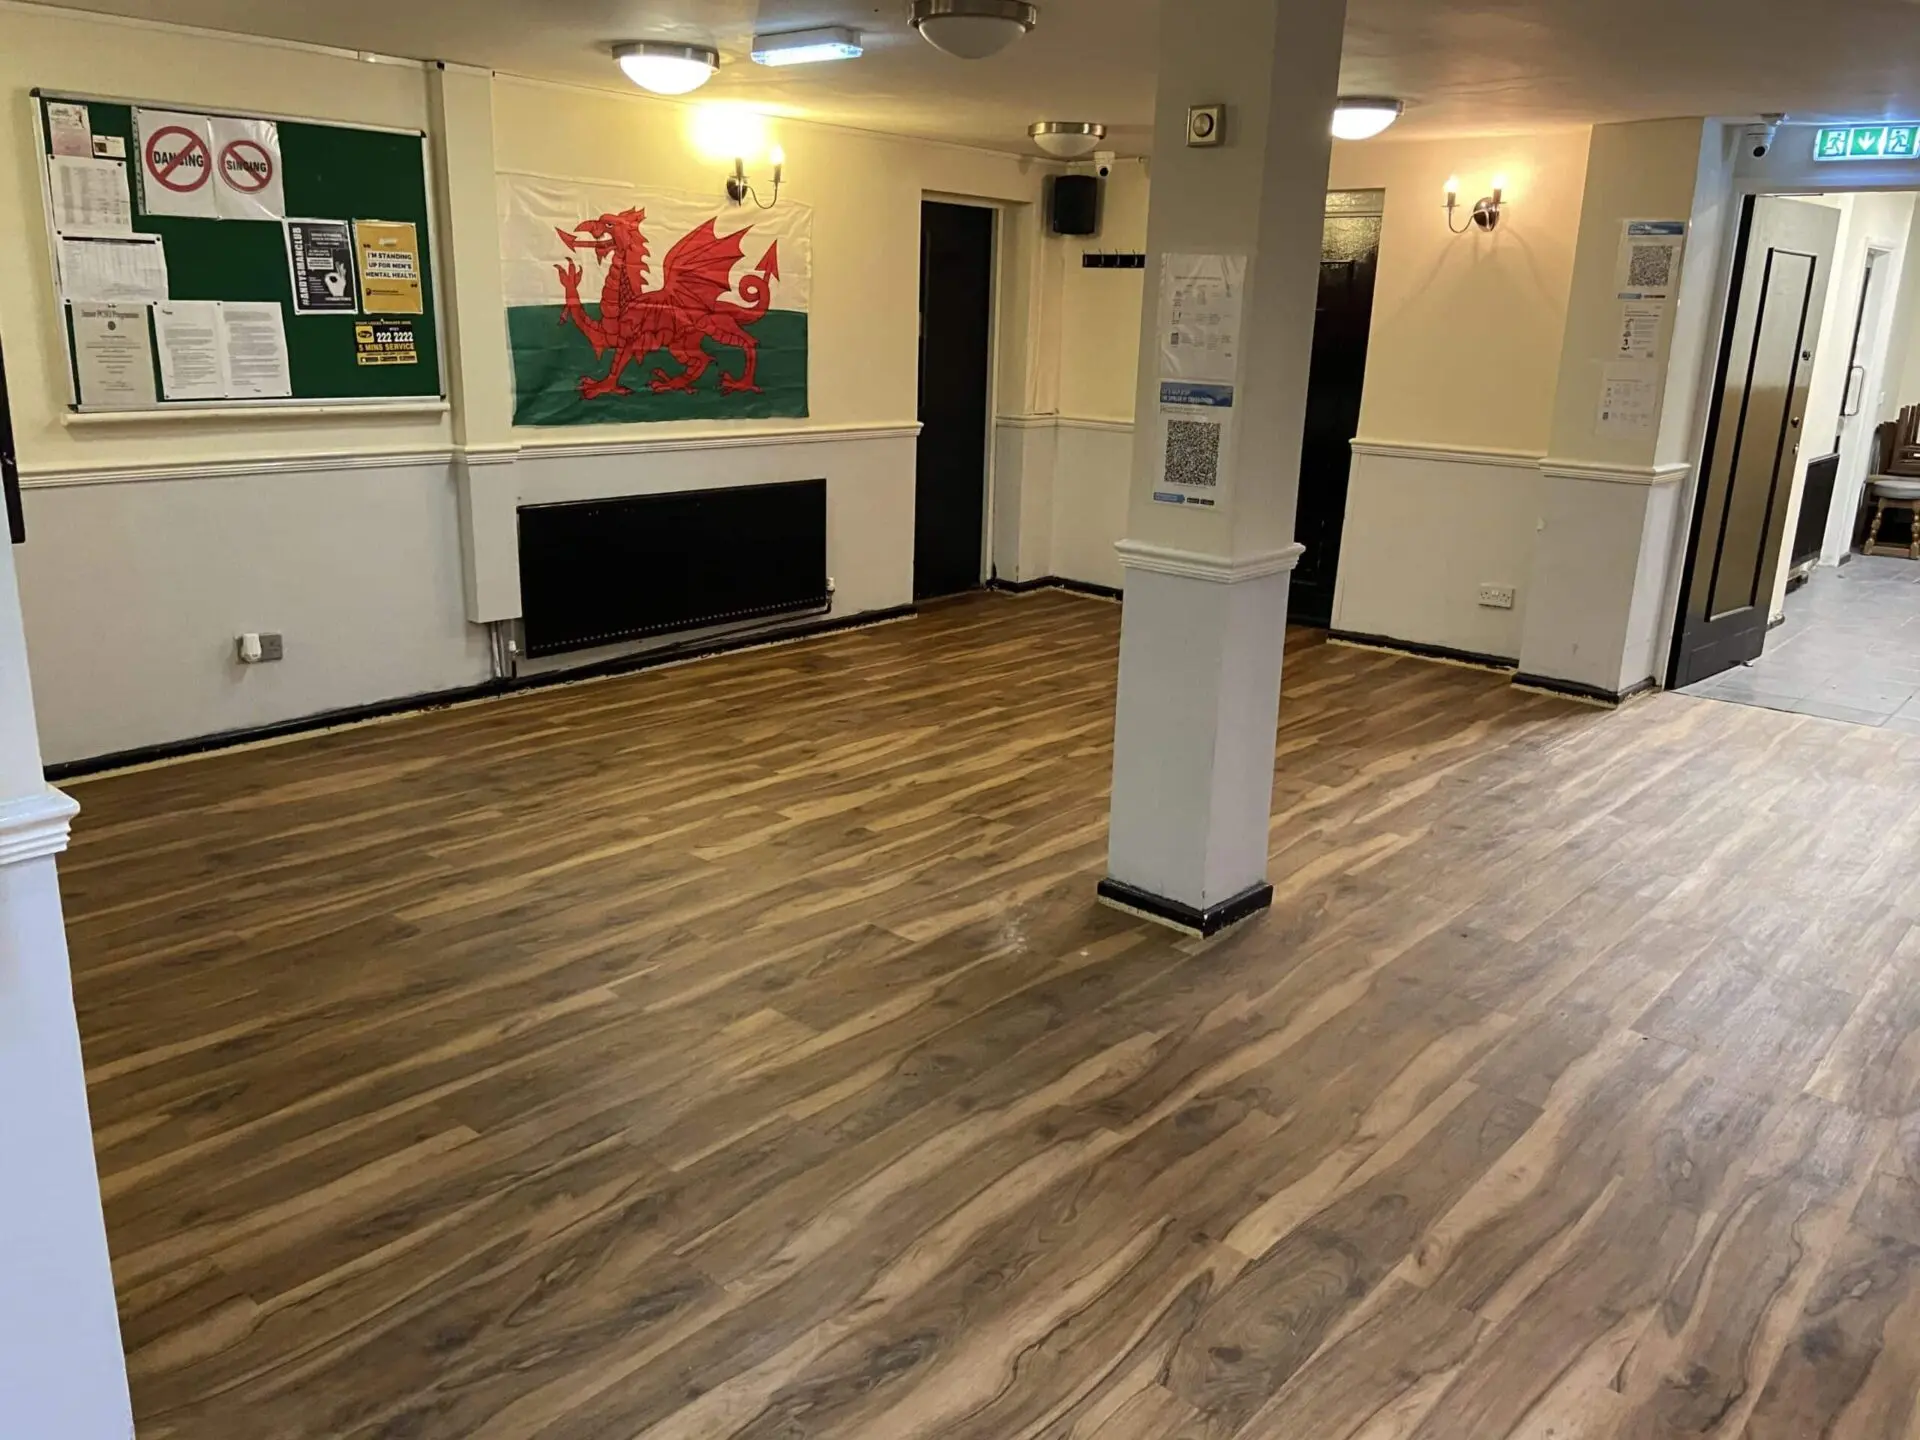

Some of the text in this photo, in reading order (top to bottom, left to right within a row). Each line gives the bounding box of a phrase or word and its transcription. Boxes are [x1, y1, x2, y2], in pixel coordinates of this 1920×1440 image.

[153, 151, 204, 167] DANING
[379, 252, 412, 260] STANDING
[292, 227, 310, 306] #ANDYSMANCLUB
[376, 332, 392, 343] 222
[393, 332, 414, 342] 2222
[364, 343, 384, 351] MINS
[384, 342, 415, 350] SERVICE
